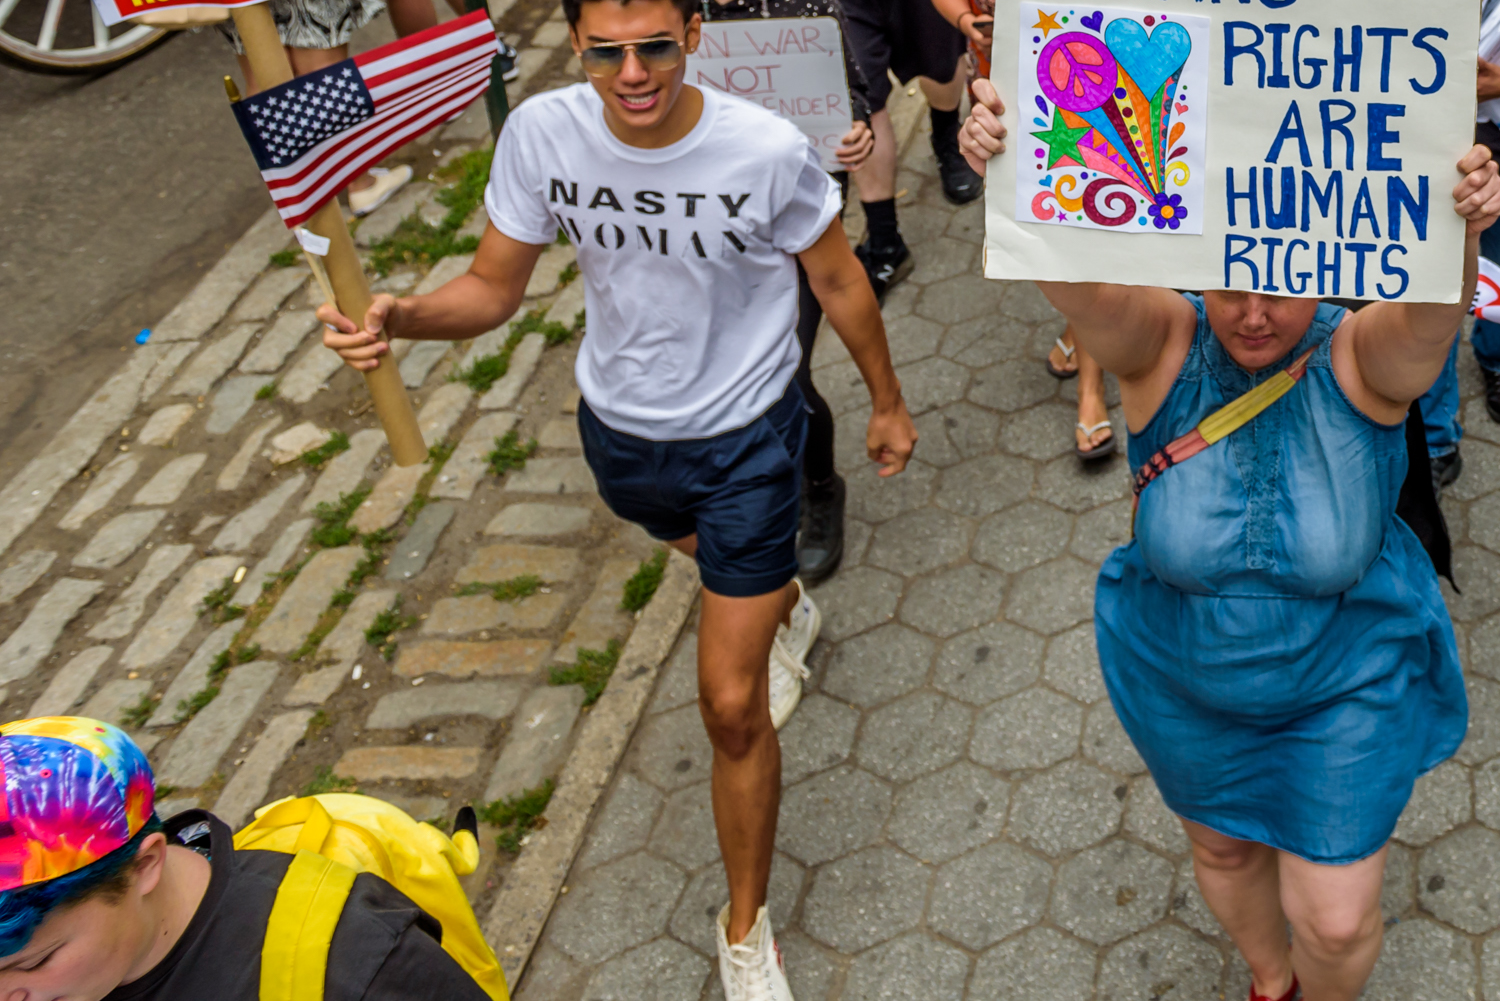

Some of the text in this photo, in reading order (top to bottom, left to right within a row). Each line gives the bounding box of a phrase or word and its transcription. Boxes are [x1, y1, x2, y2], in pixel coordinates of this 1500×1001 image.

[744, 26, 834, 57] WAR,
[1223, 21, 1448, 95] RIGHTS
[697, 64, 781, 94] NOT
[761, 93, 846, 117] ENDER
[1265, 99, 1406, 171] ARE
[549, 178, 751, 218] NASTY
[1225, 166, 1430, 241] HUMAN
[554, 213, 751, 259] WOMAN
[1223, 233, 1410, 299] RIGHTS
